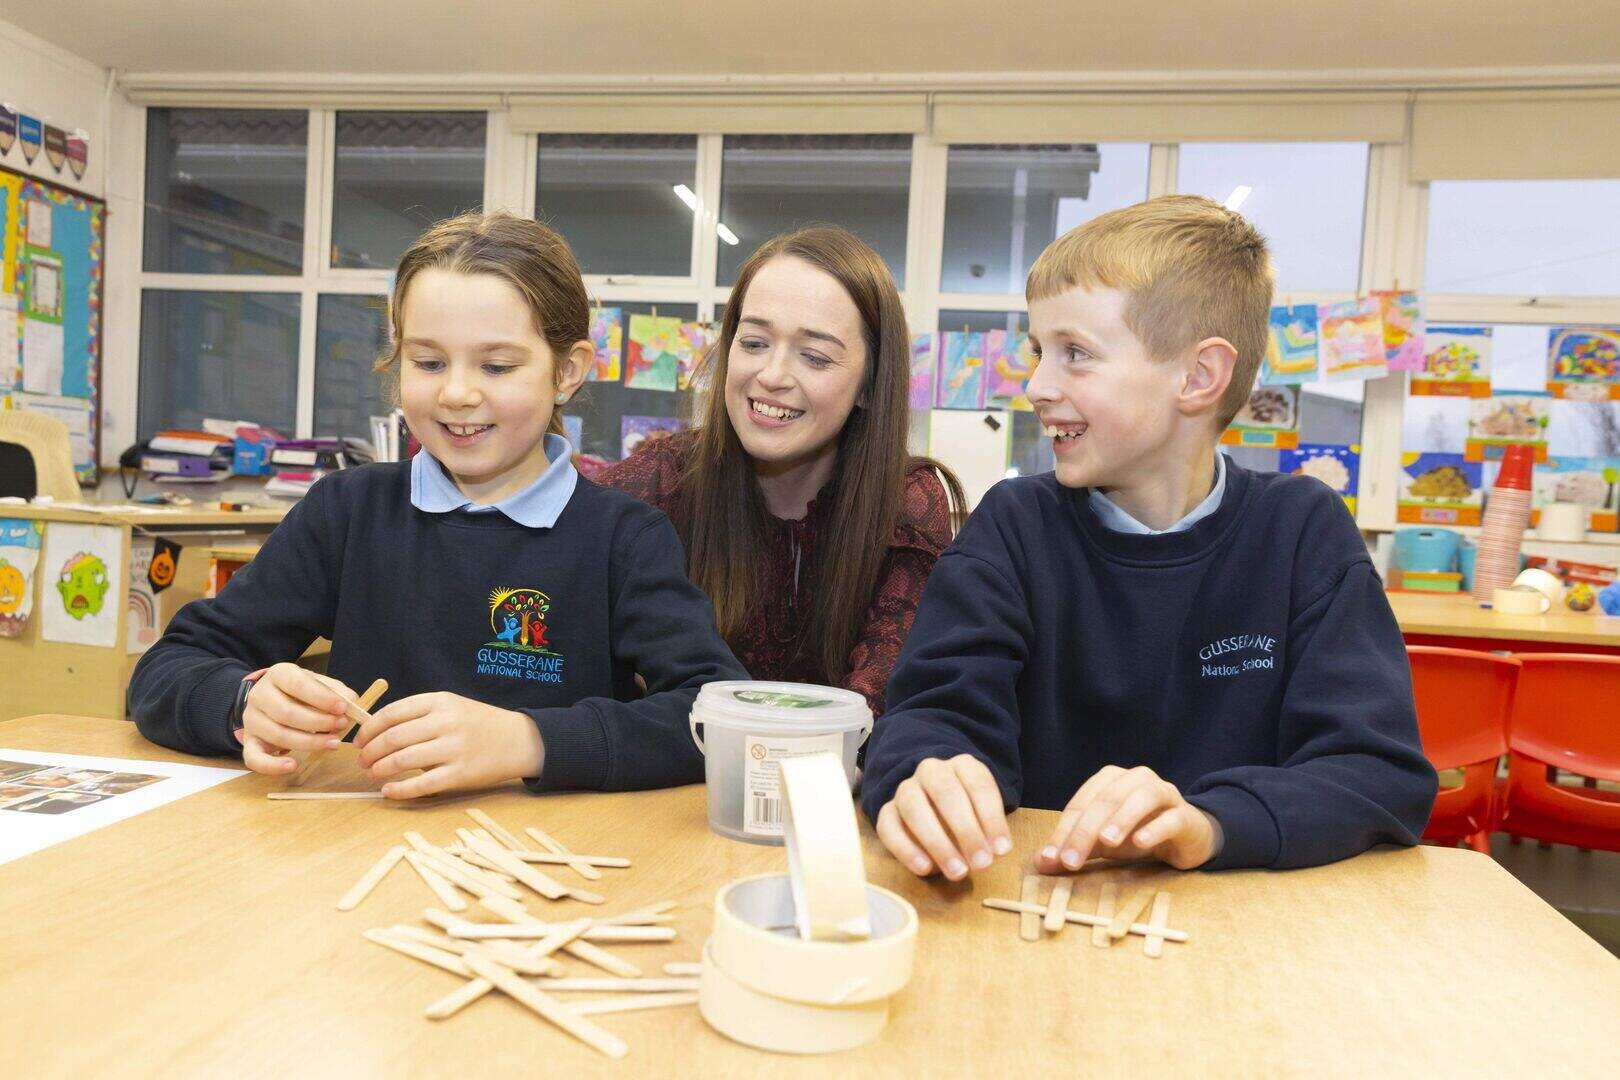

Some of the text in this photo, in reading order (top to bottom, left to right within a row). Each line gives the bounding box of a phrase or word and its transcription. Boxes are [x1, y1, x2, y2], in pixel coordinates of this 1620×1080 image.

[476, 648, 565, 672] GUSSERANE
[477, 664, 563, 683] NATIONAL SCHOOL
